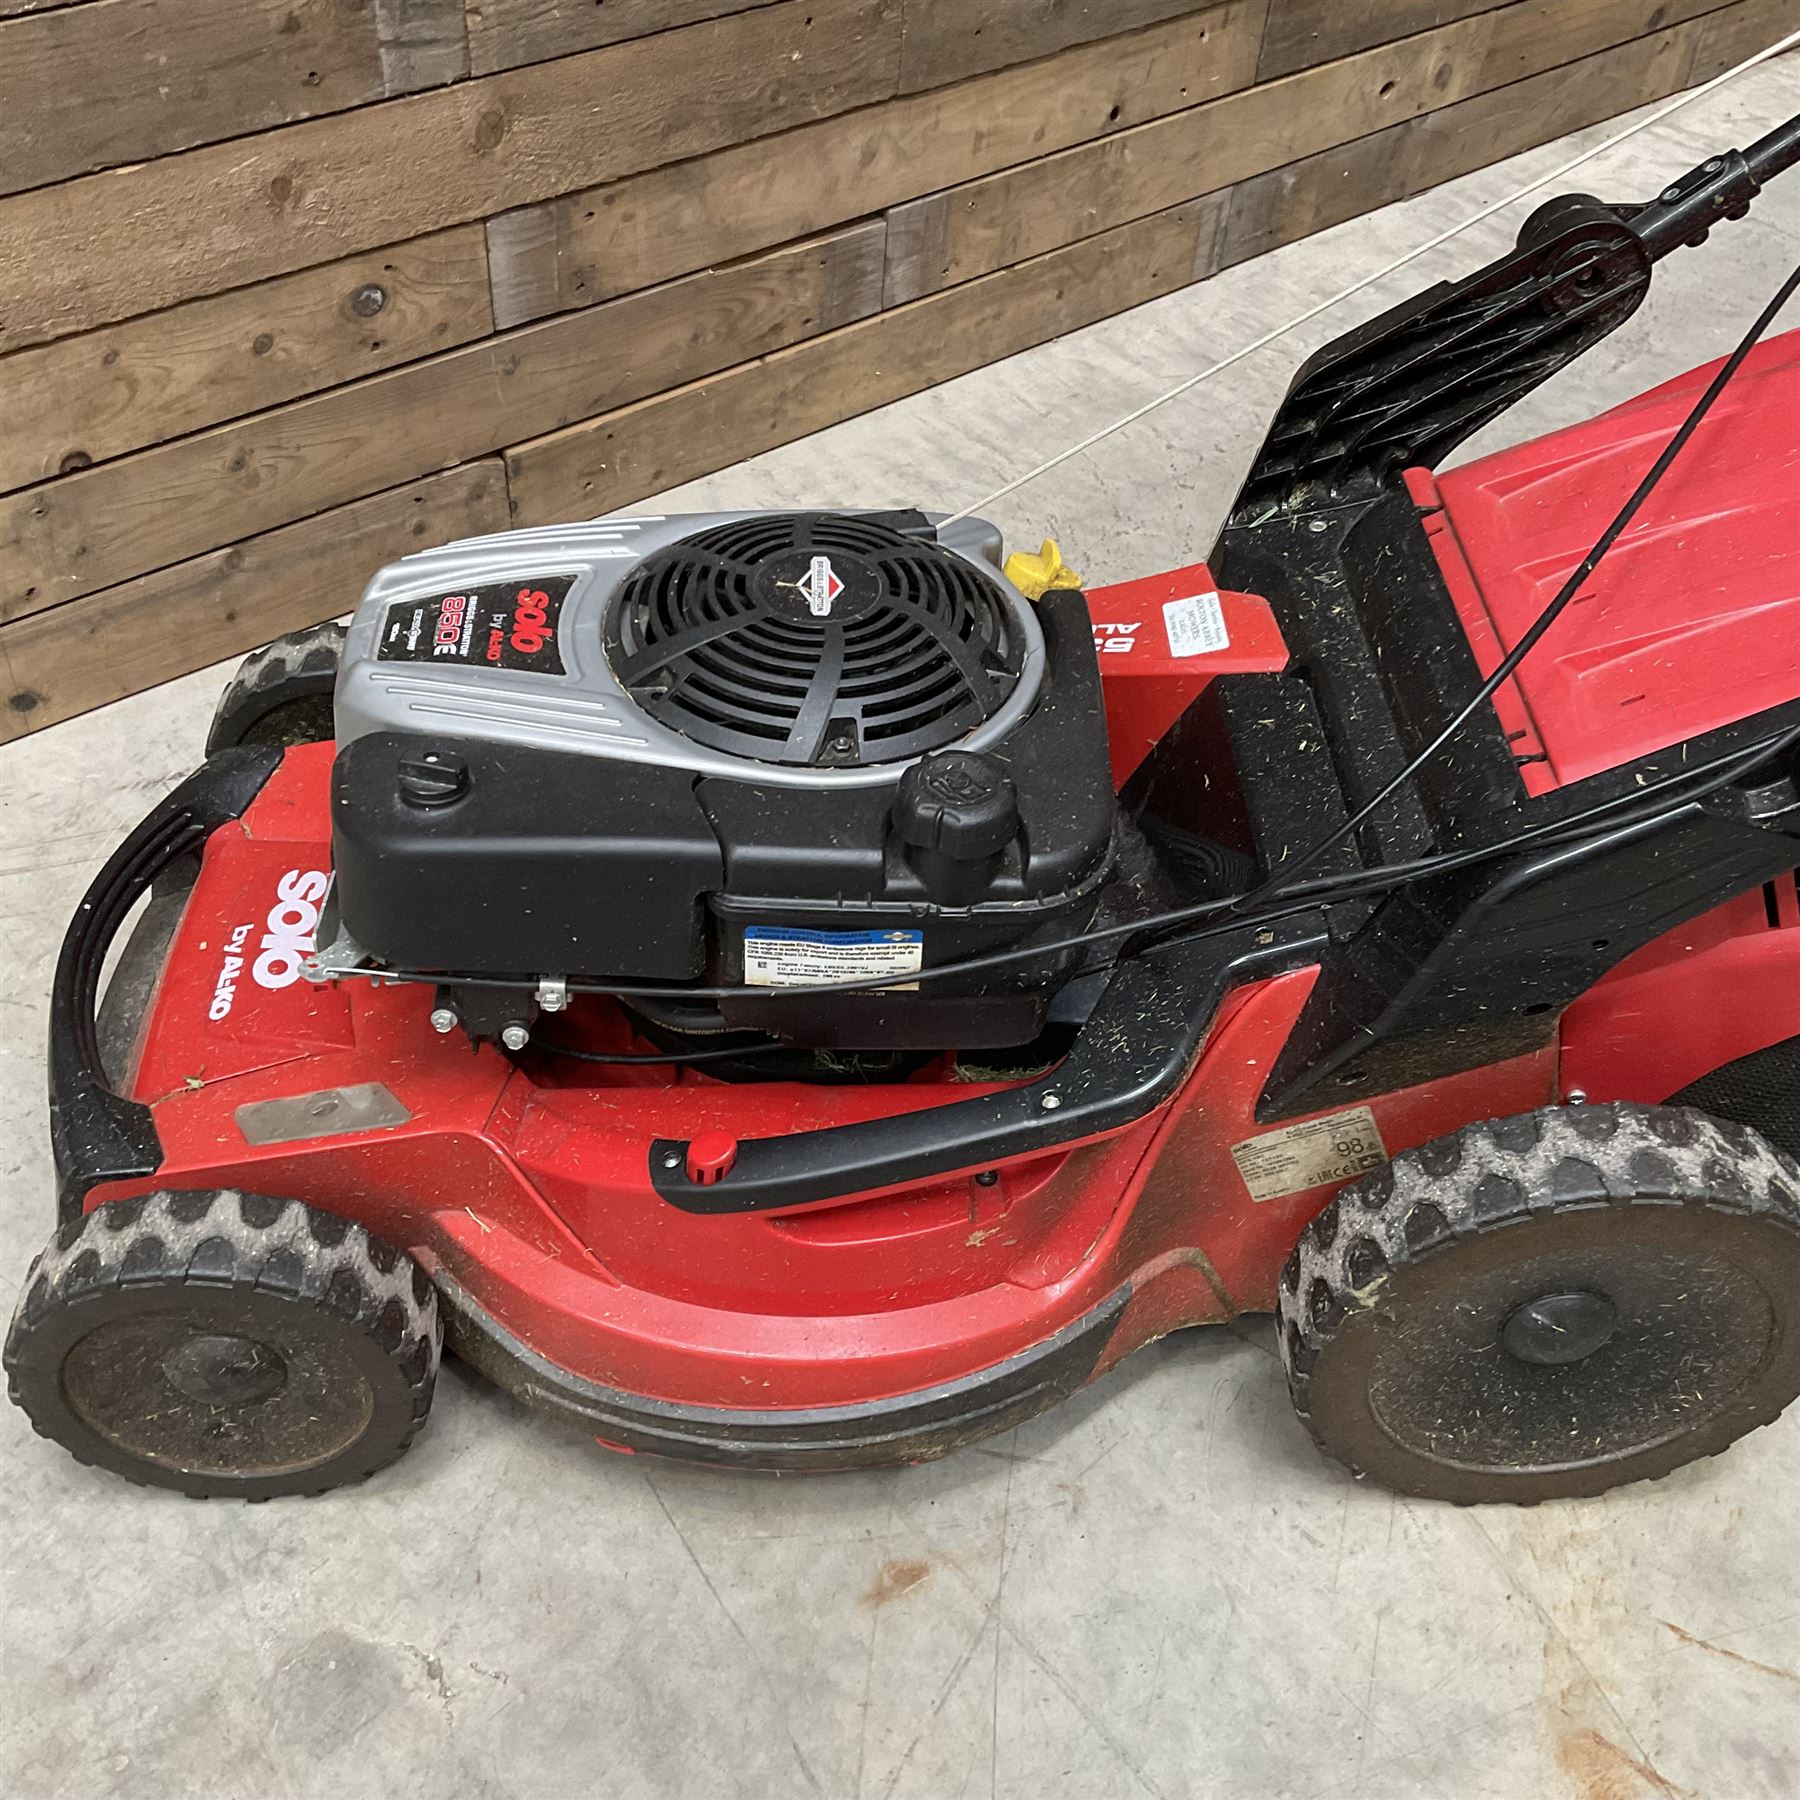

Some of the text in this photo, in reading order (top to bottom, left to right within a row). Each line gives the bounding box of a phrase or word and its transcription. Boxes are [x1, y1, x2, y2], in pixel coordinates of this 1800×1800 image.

[489, 613, 507, 629] by
[510, 588, 553, 653] solo
[223, 923, 255, 953] by
[252, 869, 328, 989] solo
[1336, 1137, 1365, 1158] 98
